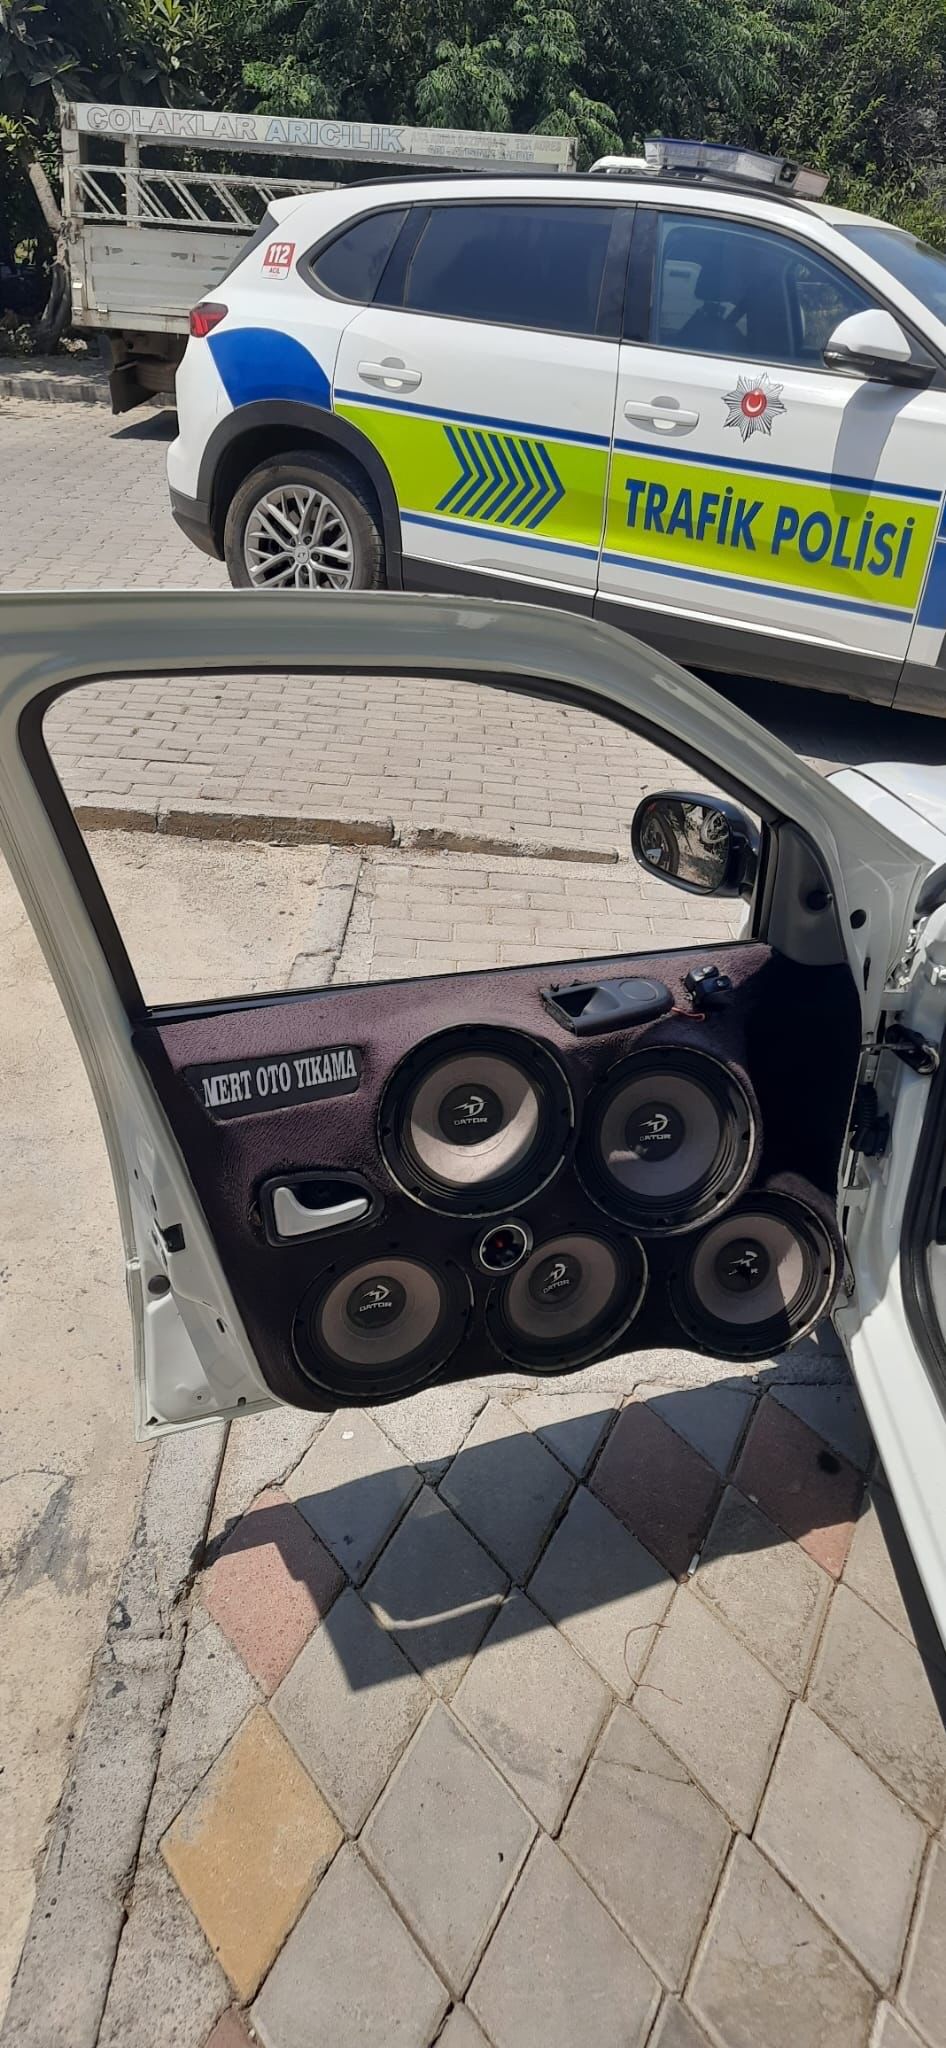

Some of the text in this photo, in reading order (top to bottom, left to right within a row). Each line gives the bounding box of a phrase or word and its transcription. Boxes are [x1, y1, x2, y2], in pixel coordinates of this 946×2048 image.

[264, 119, 405, 152] ARICILIK
[268, 244, 291, 264] 112
[625, 478, 916, 579] TRAFİK POLİSİ
[202, 1049, 357, 1107] MERT OTO YIKAMA
